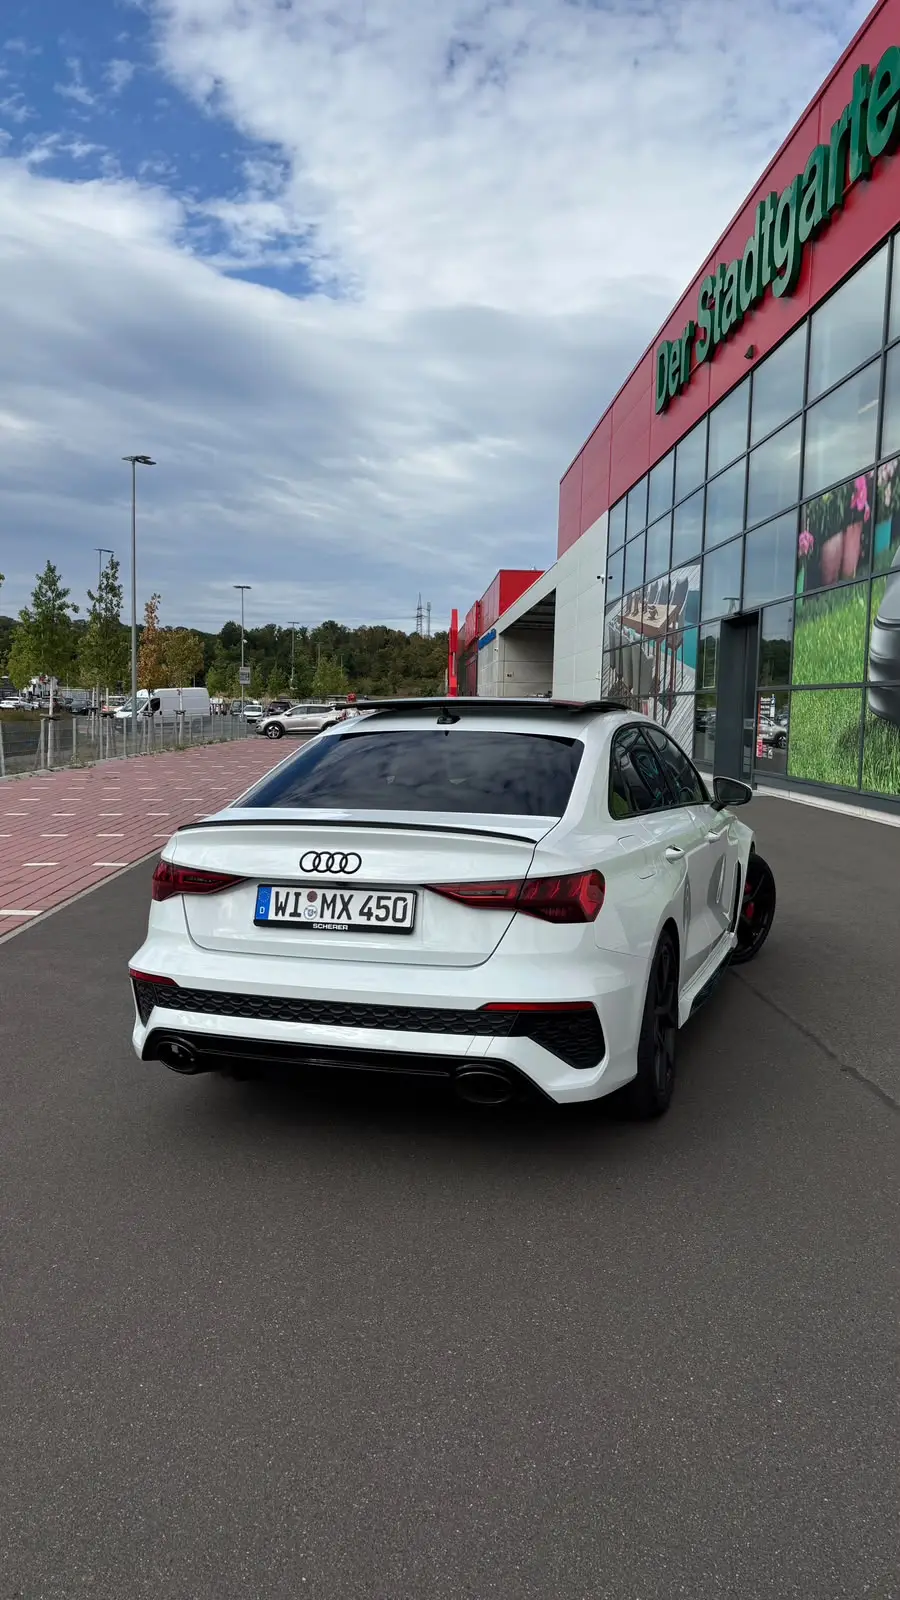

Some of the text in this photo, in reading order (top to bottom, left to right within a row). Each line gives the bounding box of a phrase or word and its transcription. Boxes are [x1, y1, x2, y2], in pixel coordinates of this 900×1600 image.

[655, 45, 900, 414] Der Stadtgarte
[259, 906, 265, 914] D
[274, 890, 408, 923] WI MX 450
[312, 922, 349, 931] SCHERER
